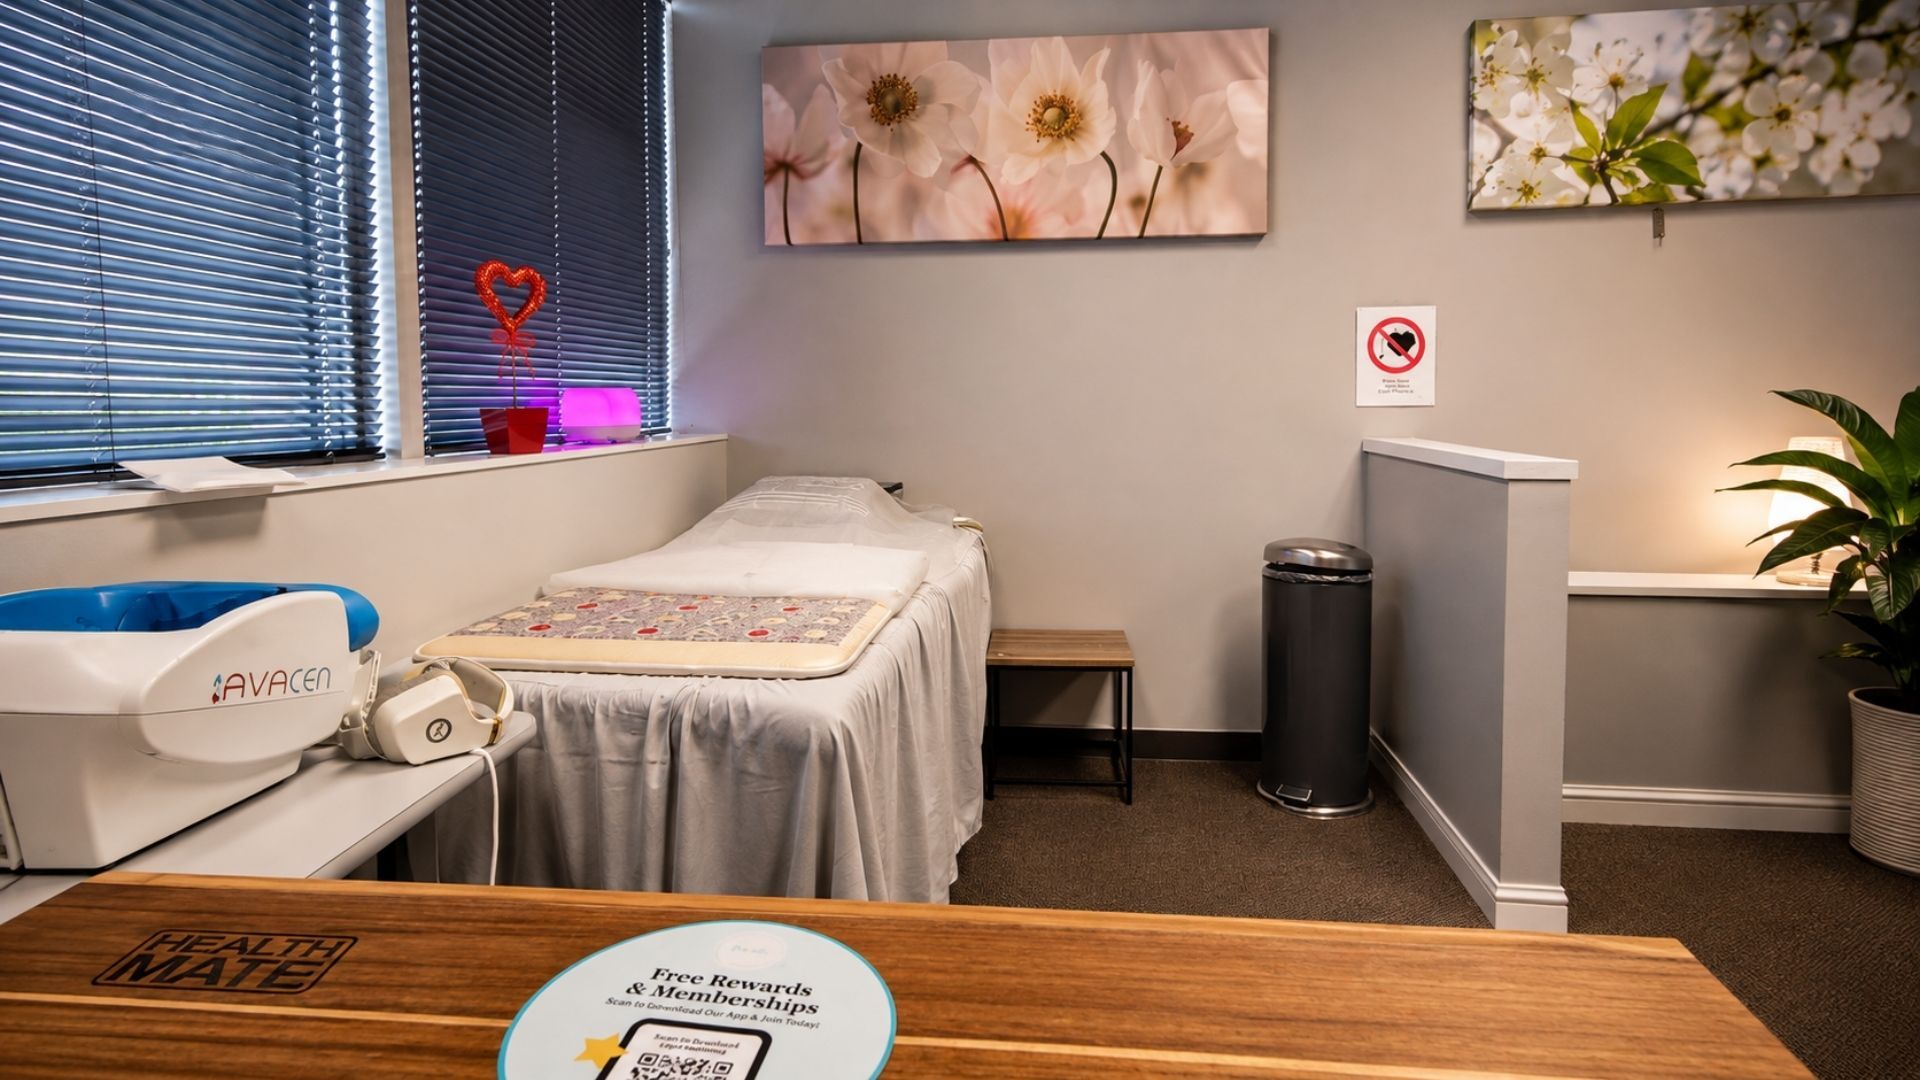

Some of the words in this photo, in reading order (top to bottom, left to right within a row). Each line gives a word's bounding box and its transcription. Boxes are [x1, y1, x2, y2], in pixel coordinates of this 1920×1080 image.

[222, 667, 331, 701] AVACEN
[144, 934, 346, 958] HEALTH
[105, 954, 325, 989] MATE
[650, 968, 704, 985] Free
[709, 974, 813, 997] Rewards
[605, 997, 632, 1007] Scan
[634, 1000, 645, 1008] to
[647, 1002, 703, 1015] Download
[705, 1009, 724, 1017] Our
[726, 1011, 748, 1021] App
[760, 1015, 783, 1024] Join
[625, 982, 647, 995] &
[650, 985, 820, 1016] Memberships
